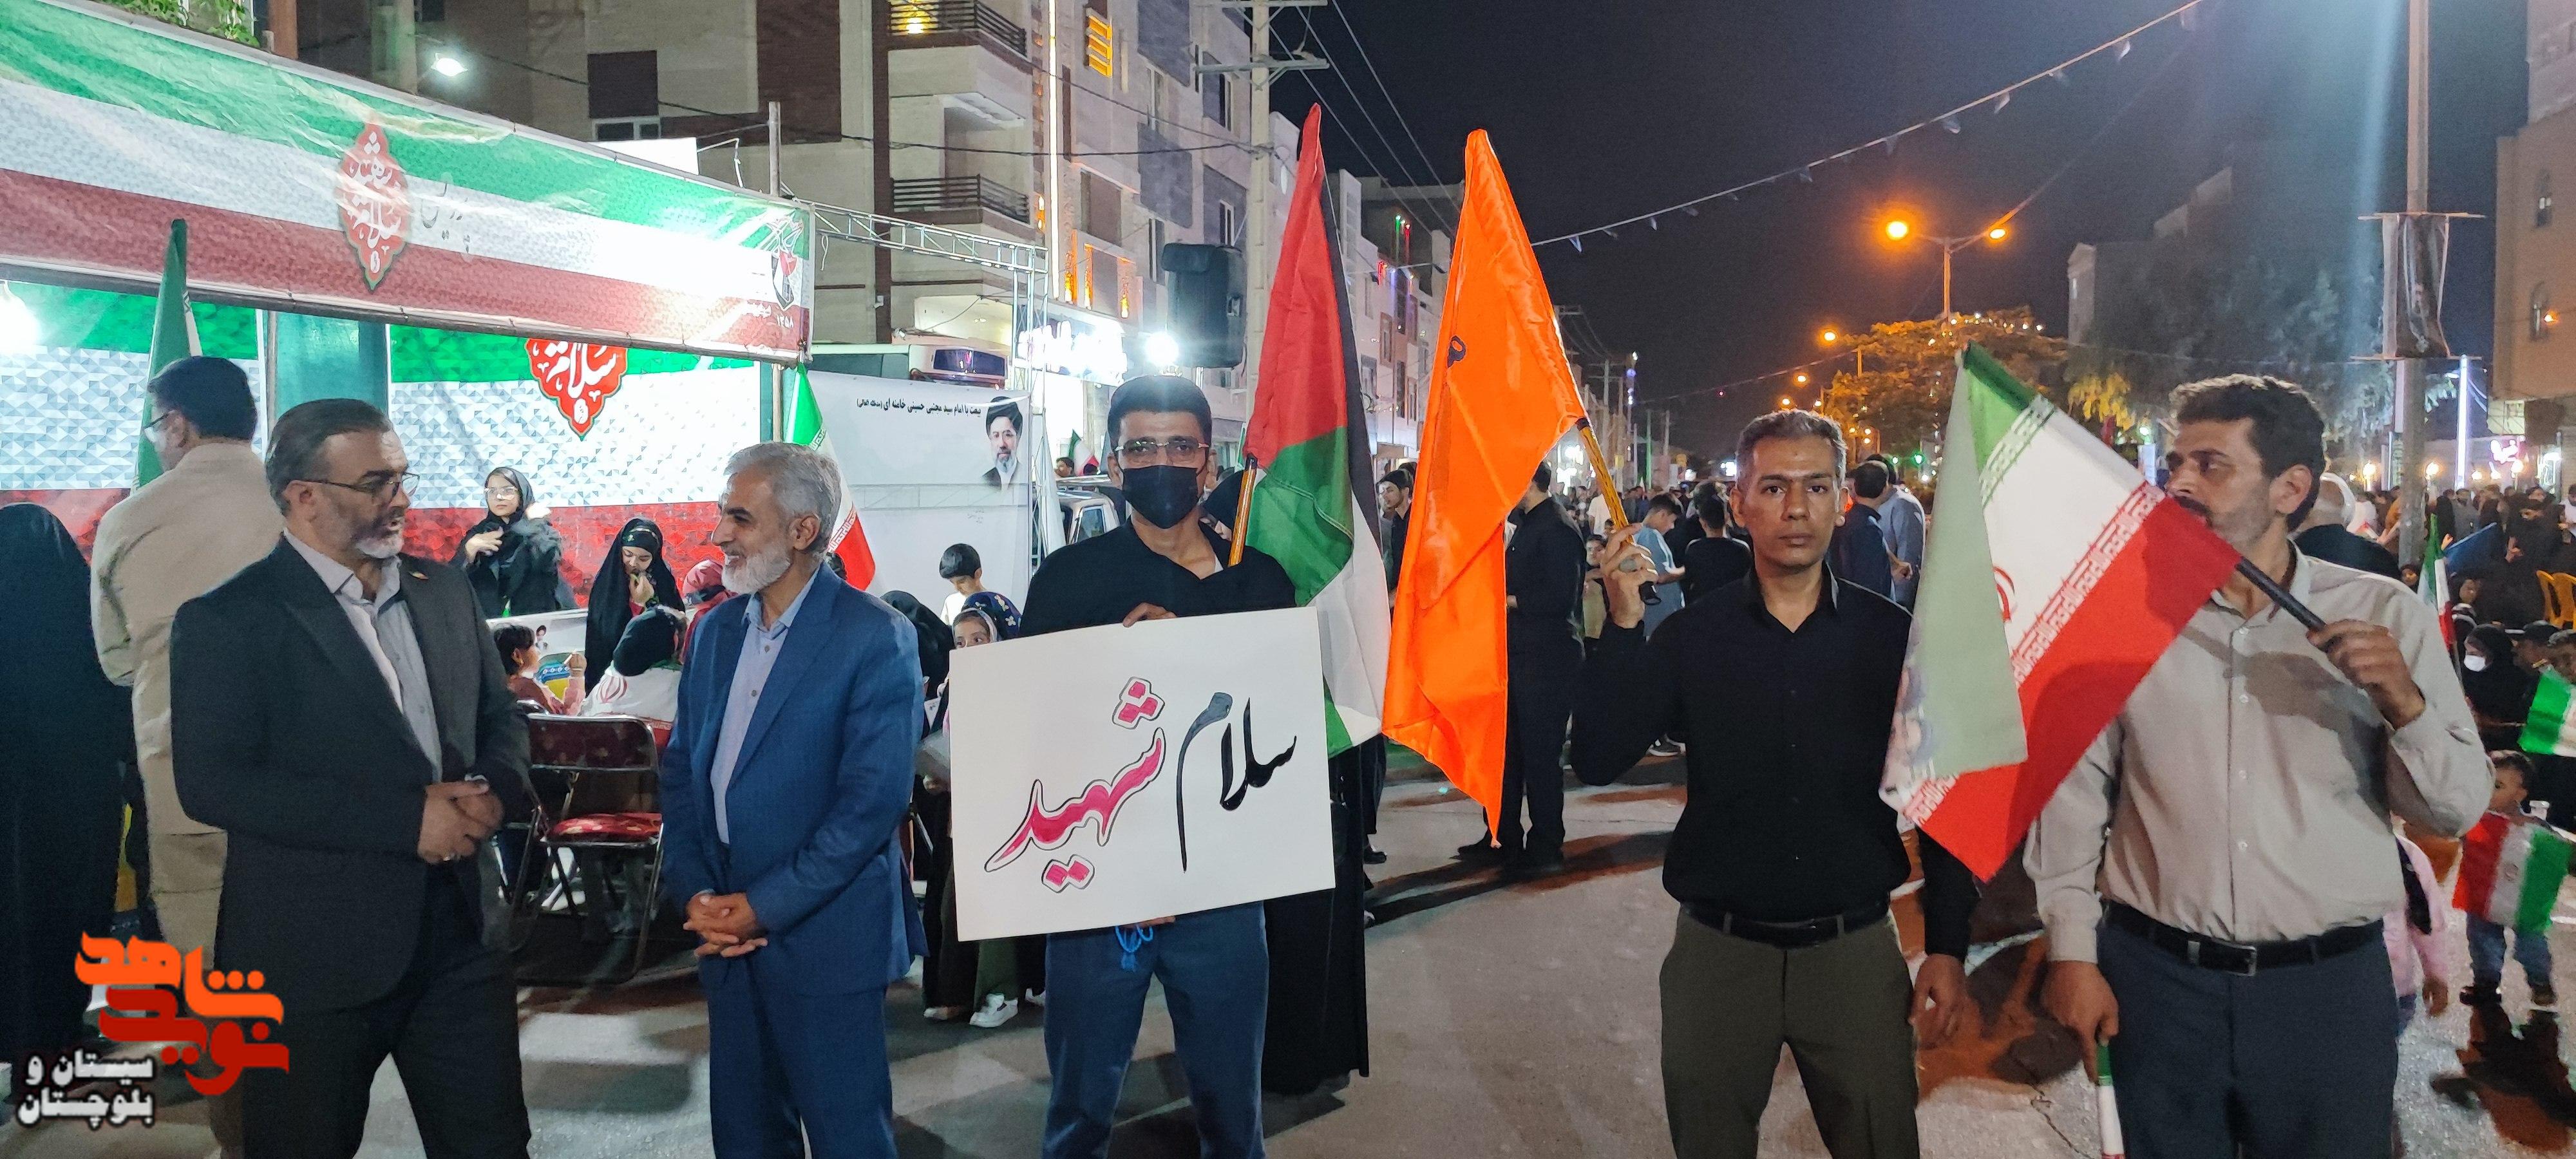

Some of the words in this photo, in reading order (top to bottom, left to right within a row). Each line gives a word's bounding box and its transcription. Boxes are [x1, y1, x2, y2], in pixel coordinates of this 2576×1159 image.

[884, 397, 891, 411] ای
[907, 401, 925, 413] حسینی
[943, 405, 953, 415] سید
[954, 404, 964, 416] امام
[984, 676, 1166, 893] شهید
[1176, 692, 1297, 873] سلام
